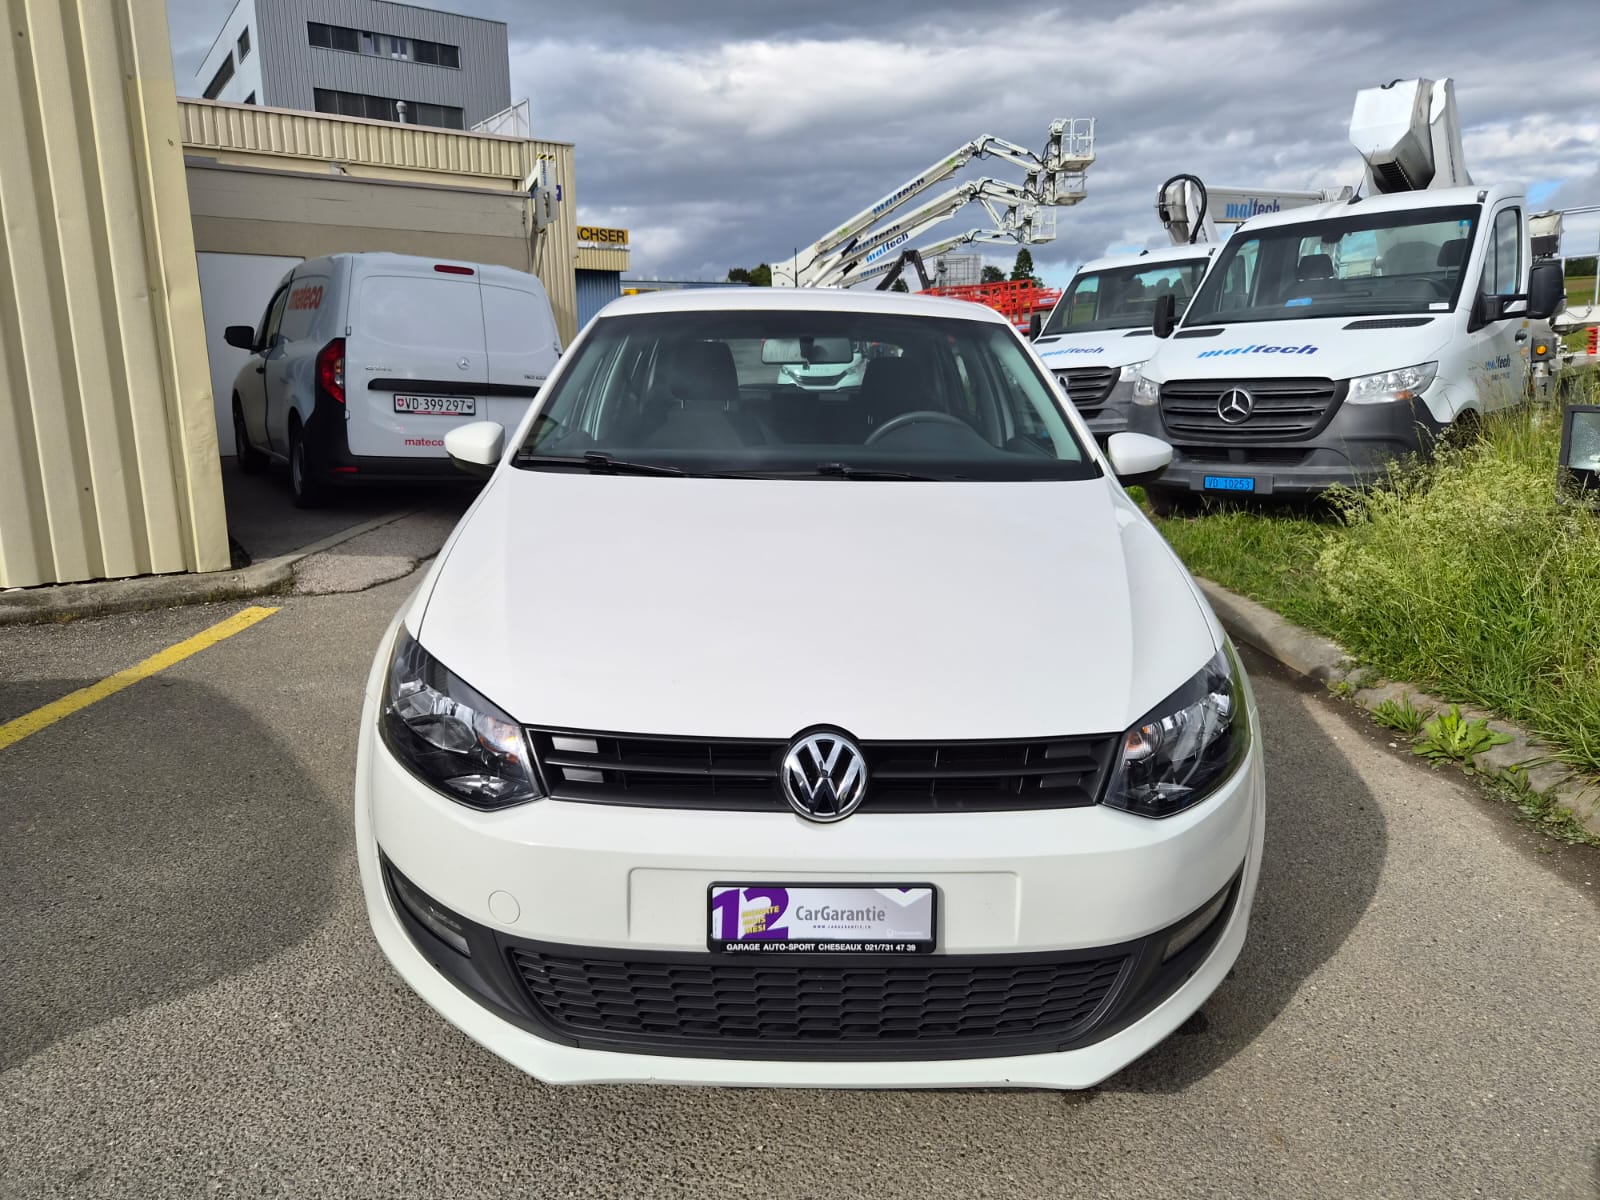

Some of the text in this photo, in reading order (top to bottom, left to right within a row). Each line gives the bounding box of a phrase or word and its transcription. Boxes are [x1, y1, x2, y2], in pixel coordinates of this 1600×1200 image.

[872, 177, 925, 214] maltech
[1226, 197, 1280, 218] maltech
[866, 232, 909, 263] maltech
[1196, 344, 1319, 359] maltech
[404, 438, 445, 447] mateco
[795, 905, 886, 922] CarGarantie
[726, 943, 761, 951] GARAGE
[763, 943, 816, 951] AUTO-SPORT
[818, 943, 862, 951] CHESEAUX
[864, 943, 894, 951] 021/731
